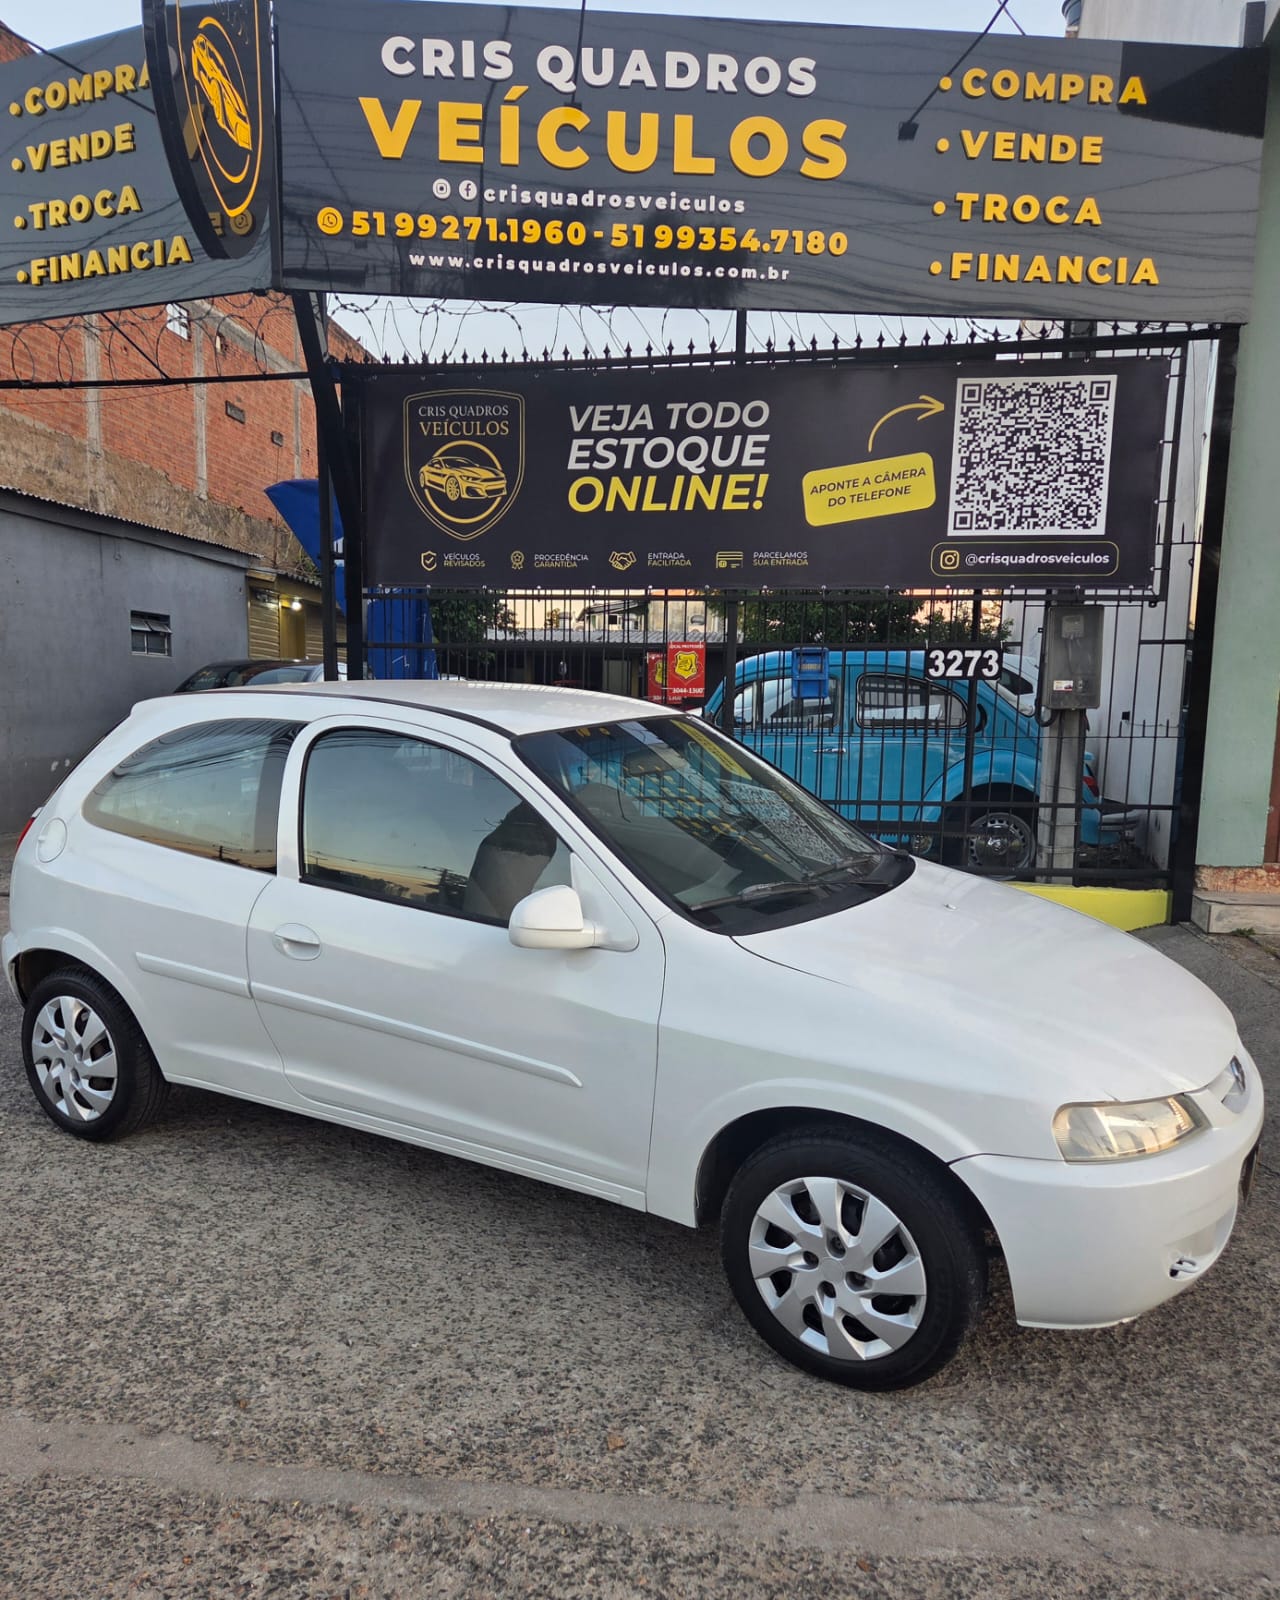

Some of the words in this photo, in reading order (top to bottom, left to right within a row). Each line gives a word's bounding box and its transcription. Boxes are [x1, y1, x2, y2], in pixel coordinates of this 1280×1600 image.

[381, 36, 514, 80] CRIS
[536, 45, 818, 97] QUADROS
[961, 67, 1148, 106] COMPRA
[26, 122, 135, 172] VENDE
[358, 85, 849, 181] VEÍCULOS
[960, 129, 1104, 164] VENDE
[28, 185, 142, 230] TROCA
[483, 184, 746, 214] crisquadrosveiculos
[955, 192, 1102, 226] TROCA
[351, 210, 386, 237] 51
[394, 212, 587, 247] 99271.1960
[610, 223, 645, 249] 51
[653, 225, 849, 257] 99354.7180
[30, 235, 193, 286] FINANCIA
[408, 254, 790, 281] www.crisquadrosveiculos.com.br
[950, 252, 1160, 286] FINANCIA
[418, 405, 446, 417] CRIS
[448, 404, 509, 419] QUADROS
[568, 403, 654, 432] VEJA
[666, 400, 770, 430] TODO
[419, 418, 510, 436] VEÍCULOS
[567, 434, 771, 475] ESTOQUE
[567, 473, 770, 513] ONLINE!
[810, 478, 860, 496] APONTE
[862, 477, 871, 487] A
[874, 467, 927, 485] CÂMERA
[828, 496, 847, 508] DO
[849, 485, 912, 504] TELEFONE
[443, 551, 481, 561] VEÍCULOS
[443, 560, 486, 568] REVISADOS
[534, 552, 589, 562] PROCEDÊNCIA
[647, 552, 685, 560] ENTRADA
[647, 559, 692, 568] FACILITADA
[752, 551, 808, 559] PARCELAMOS
[752, 558, 769, 566] SUA
[770, 558, 809, 567] ENTRADA
[965, 552, 1110, 566] @crisquadrosveiculos
[928, 649, 999, 677] 3273
